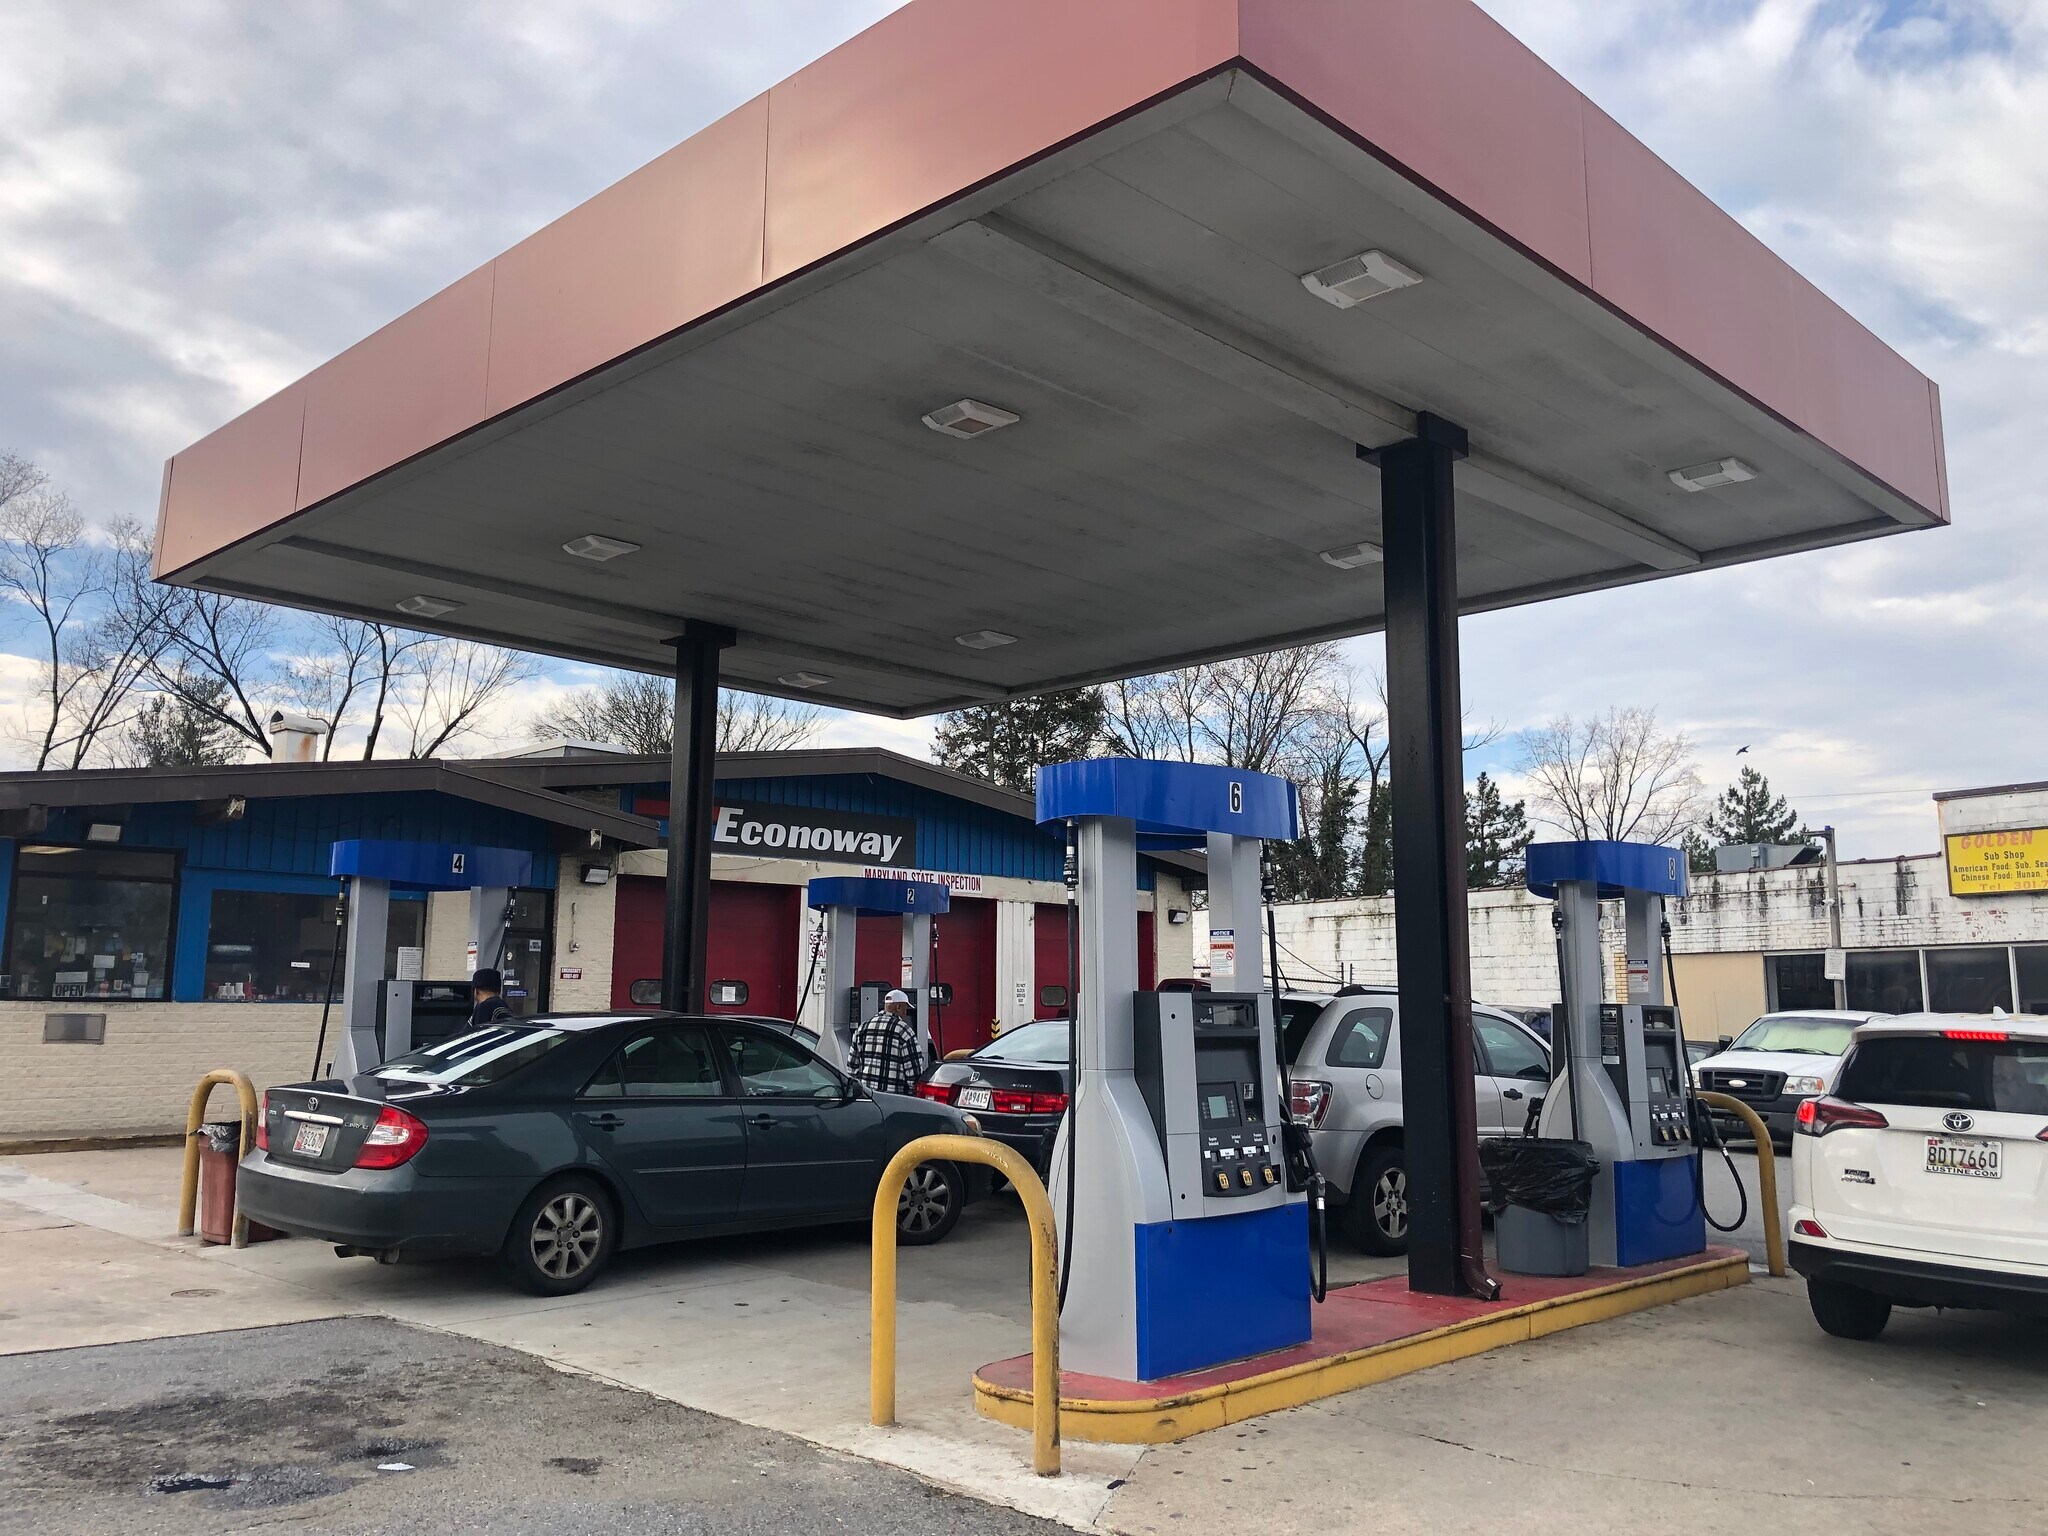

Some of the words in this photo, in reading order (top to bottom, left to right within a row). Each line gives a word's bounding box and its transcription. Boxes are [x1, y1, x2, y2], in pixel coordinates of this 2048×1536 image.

[1231, 783, 1241, 811] 6
[713, 806, 903, 862] Econoway
[1960, 830, 2033, 849] GOLDEN
[1984, 852, 2000, 861] Sub
[2003, 851, 2025, 860] Shop
[453, 855, 463, 872] 4
[1953, 865, 1988, 873] American
[1992, 863, 2012, 871] Food:
[2035, 860, 2048, 868] Sea
[911, 871, 934, 883] STATE
[937, 874, 981, 891] INSPECTION
[1961, 873, 1990, 882] Chinese
[1993, 871, 2013, 880] Food:
[2014, 880, 2048, 890] 301-7
[908, 889, 914, 903] 2
[55, 984, 85, 997] OPEN
[1928, 1146, 1998, 1168] 8DT7660
[1926, 1165, 1998, 1177] LUSTINE.COM
